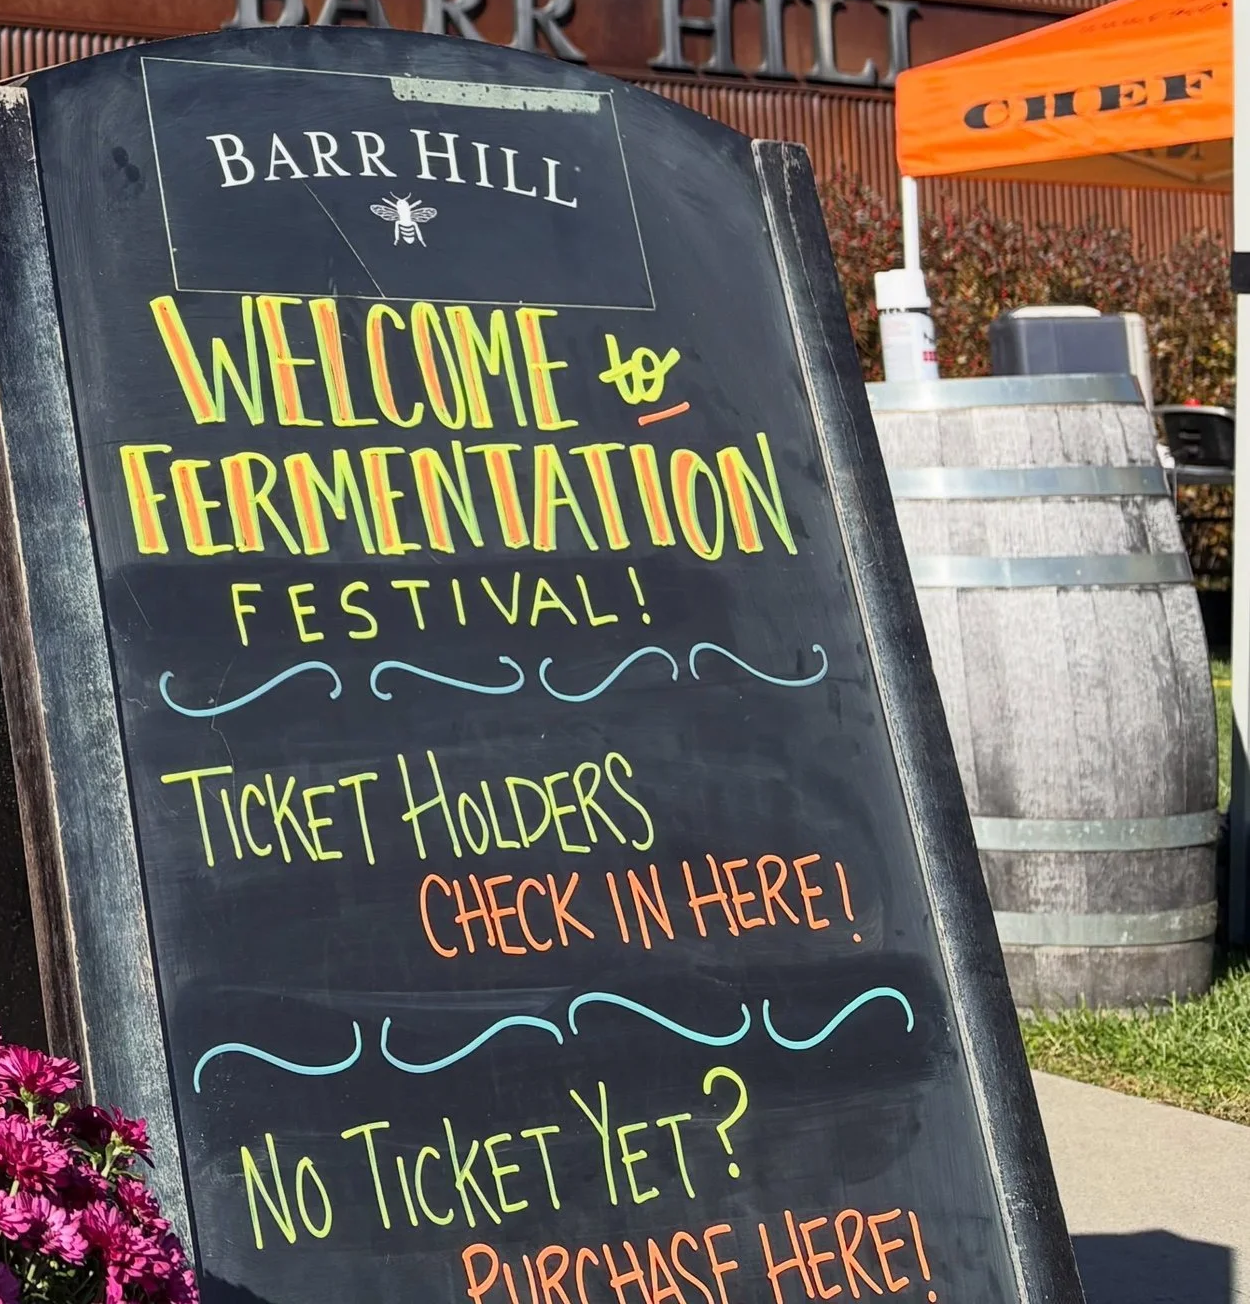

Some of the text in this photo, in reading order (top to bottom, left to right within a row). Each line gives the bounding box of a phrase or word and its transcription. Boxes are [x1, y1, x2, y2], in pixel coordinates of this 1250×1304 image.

[963, 69, 1213, 130] CHEF
[206, 128, 578, 209] BARR HILL
[149, 294, 680, 431] WELCOME to
[119, 431, 797, 561] FERMENTATION
[230, 566, 653, 647] FESTIVAL!
[161, 749, 656, 866] TICKET HOLDERS
[418, 852, 863, 958] CHECK IN HERE!
[240, 1065, 749, 1250] NO TICKET YET?
[461, 1207, 937, 1304] PURCHASE HERE!
